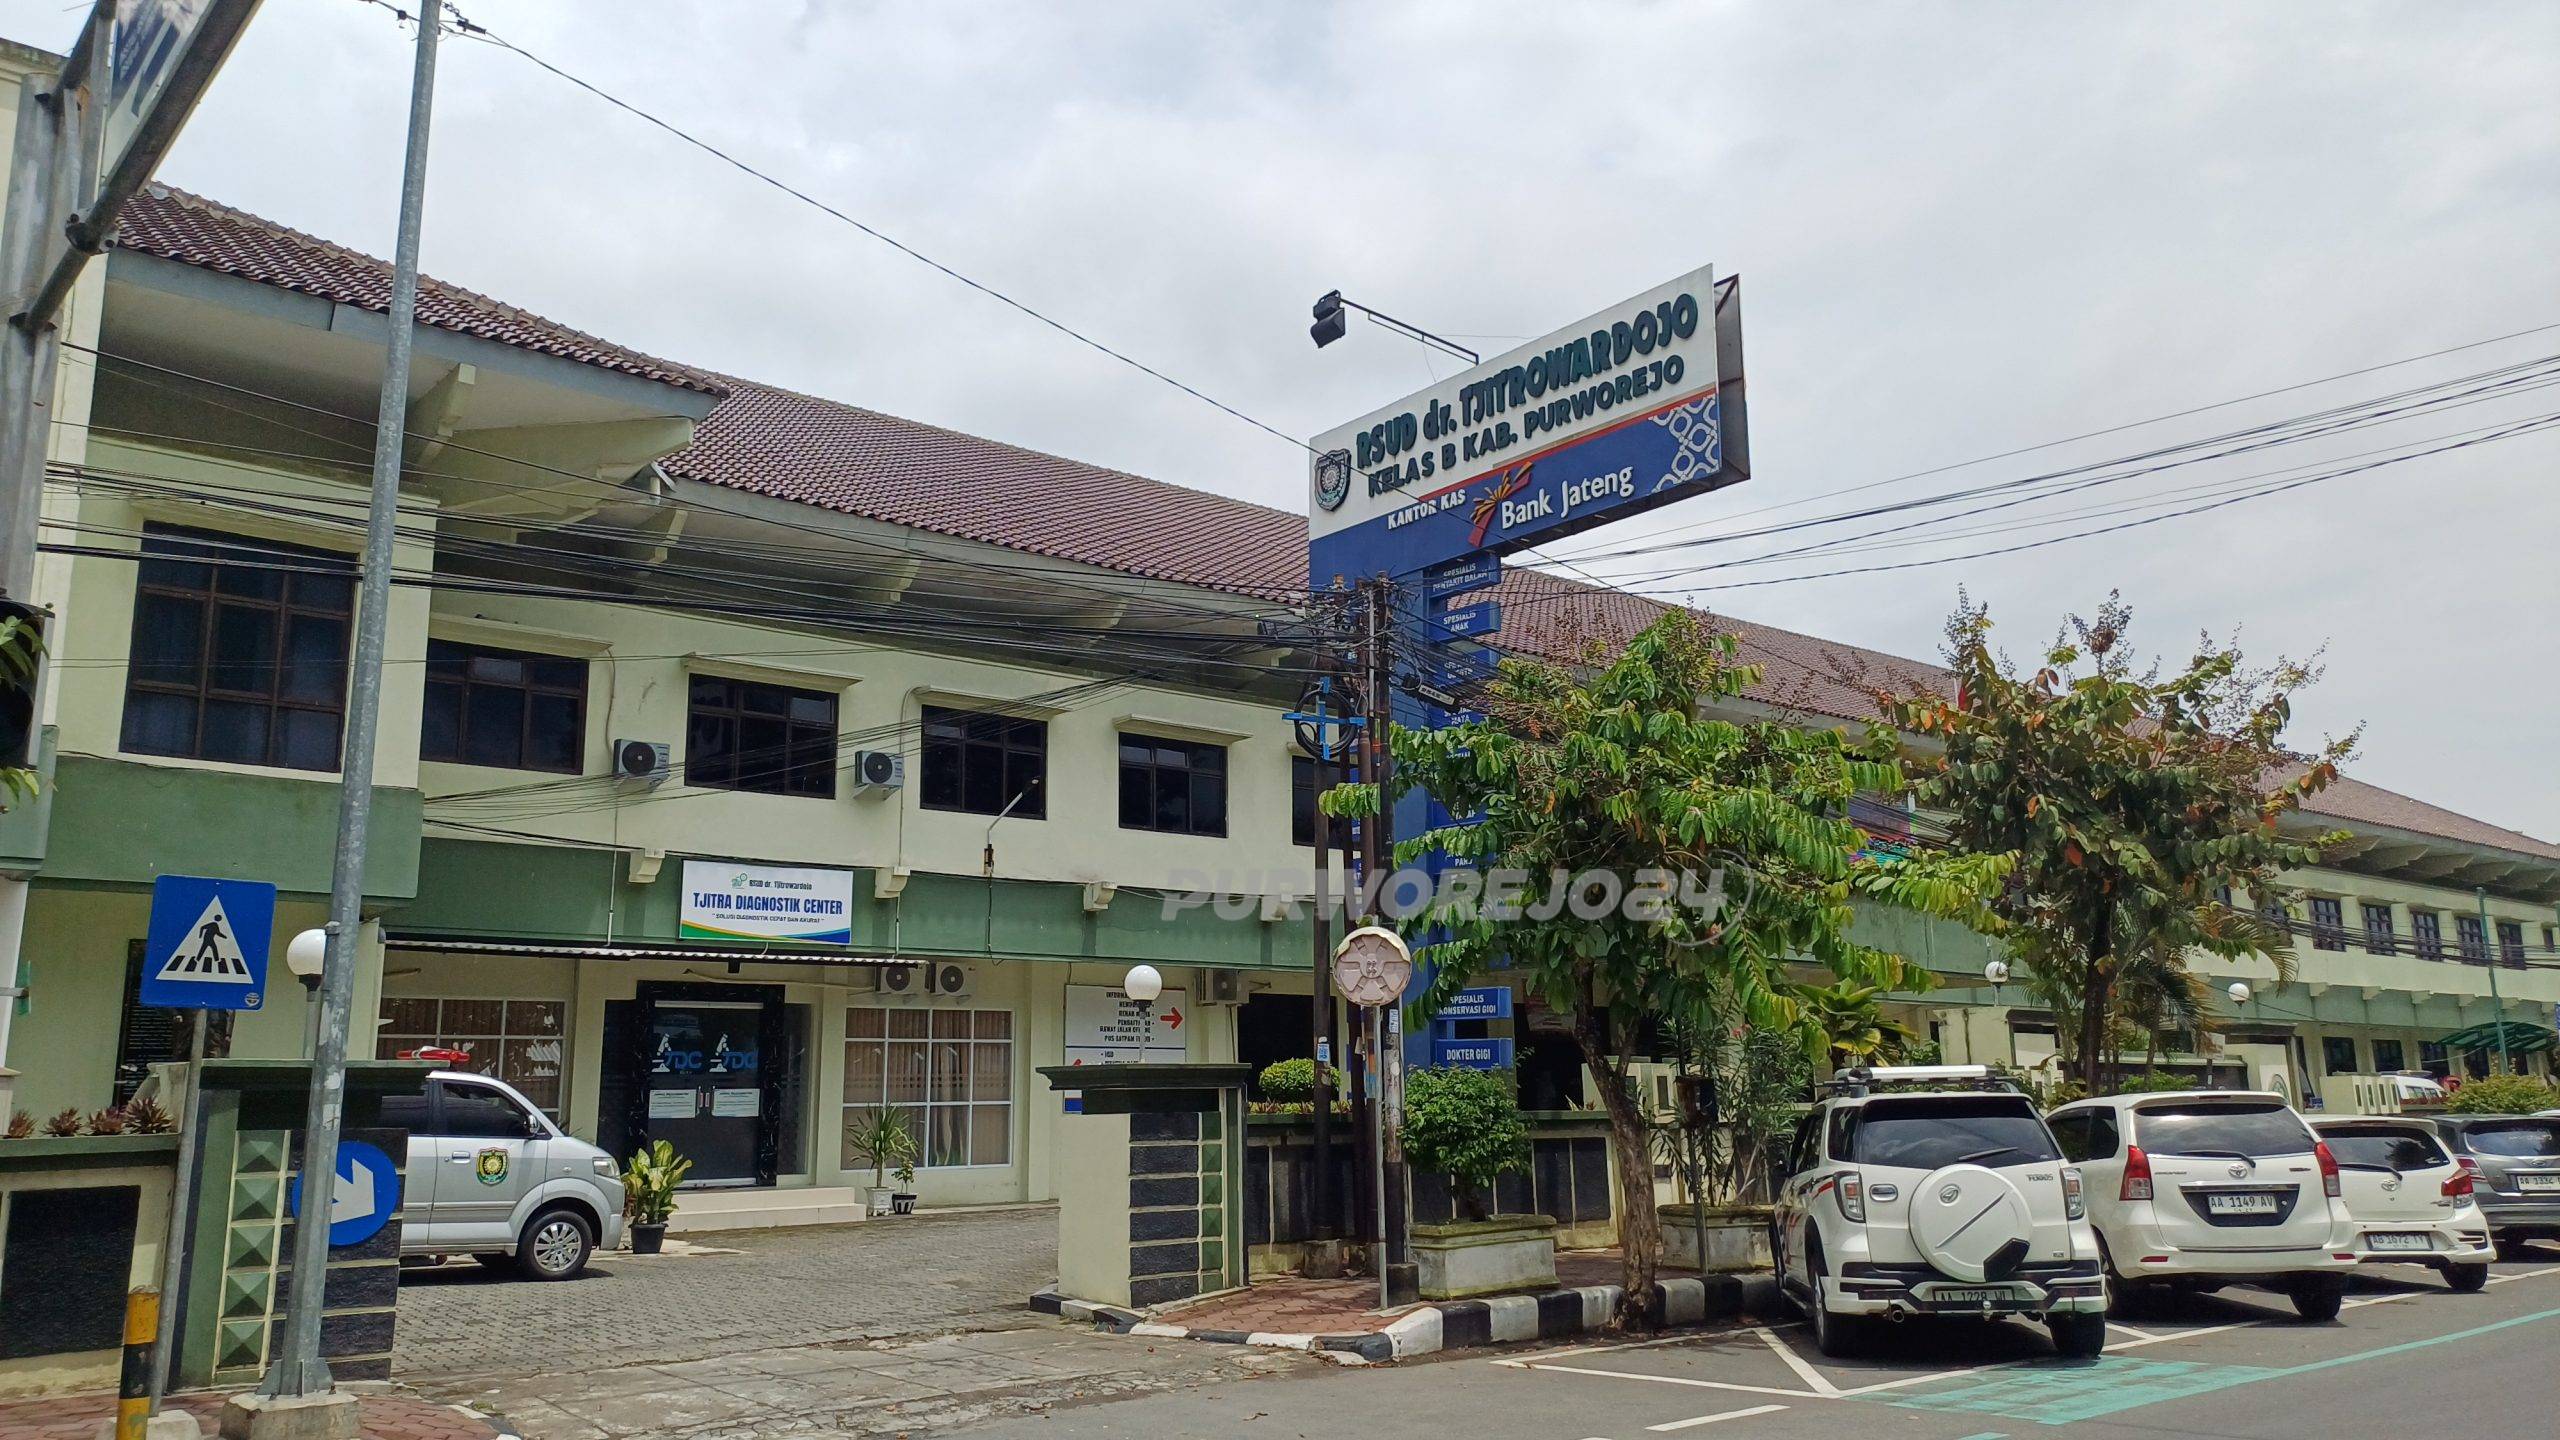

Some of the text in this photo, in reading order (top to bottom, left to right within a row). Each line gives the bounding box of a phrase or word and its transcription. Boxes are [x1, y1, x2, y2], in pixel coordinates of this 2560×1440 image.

[1357, 293, 1698, 469] RSUD dr. TJITROWARDOJO
[1368, 354, 1685, 498] KELAS B KAB. PURWOREJO
[1387, 489, 1466, 530] KANTOR KAS
[1501, 466, 1634, 530] Bank Jateng
[693, 892, 843, 915] TJITRA DIAGNOSTIK CENTER
[1482, 1005, 1496, 1013] GIGI
[1446, 1048, 1490, 1060] DOKTER GIGI
[2211, 1196, 2273, 1208] AA 1149 AV
